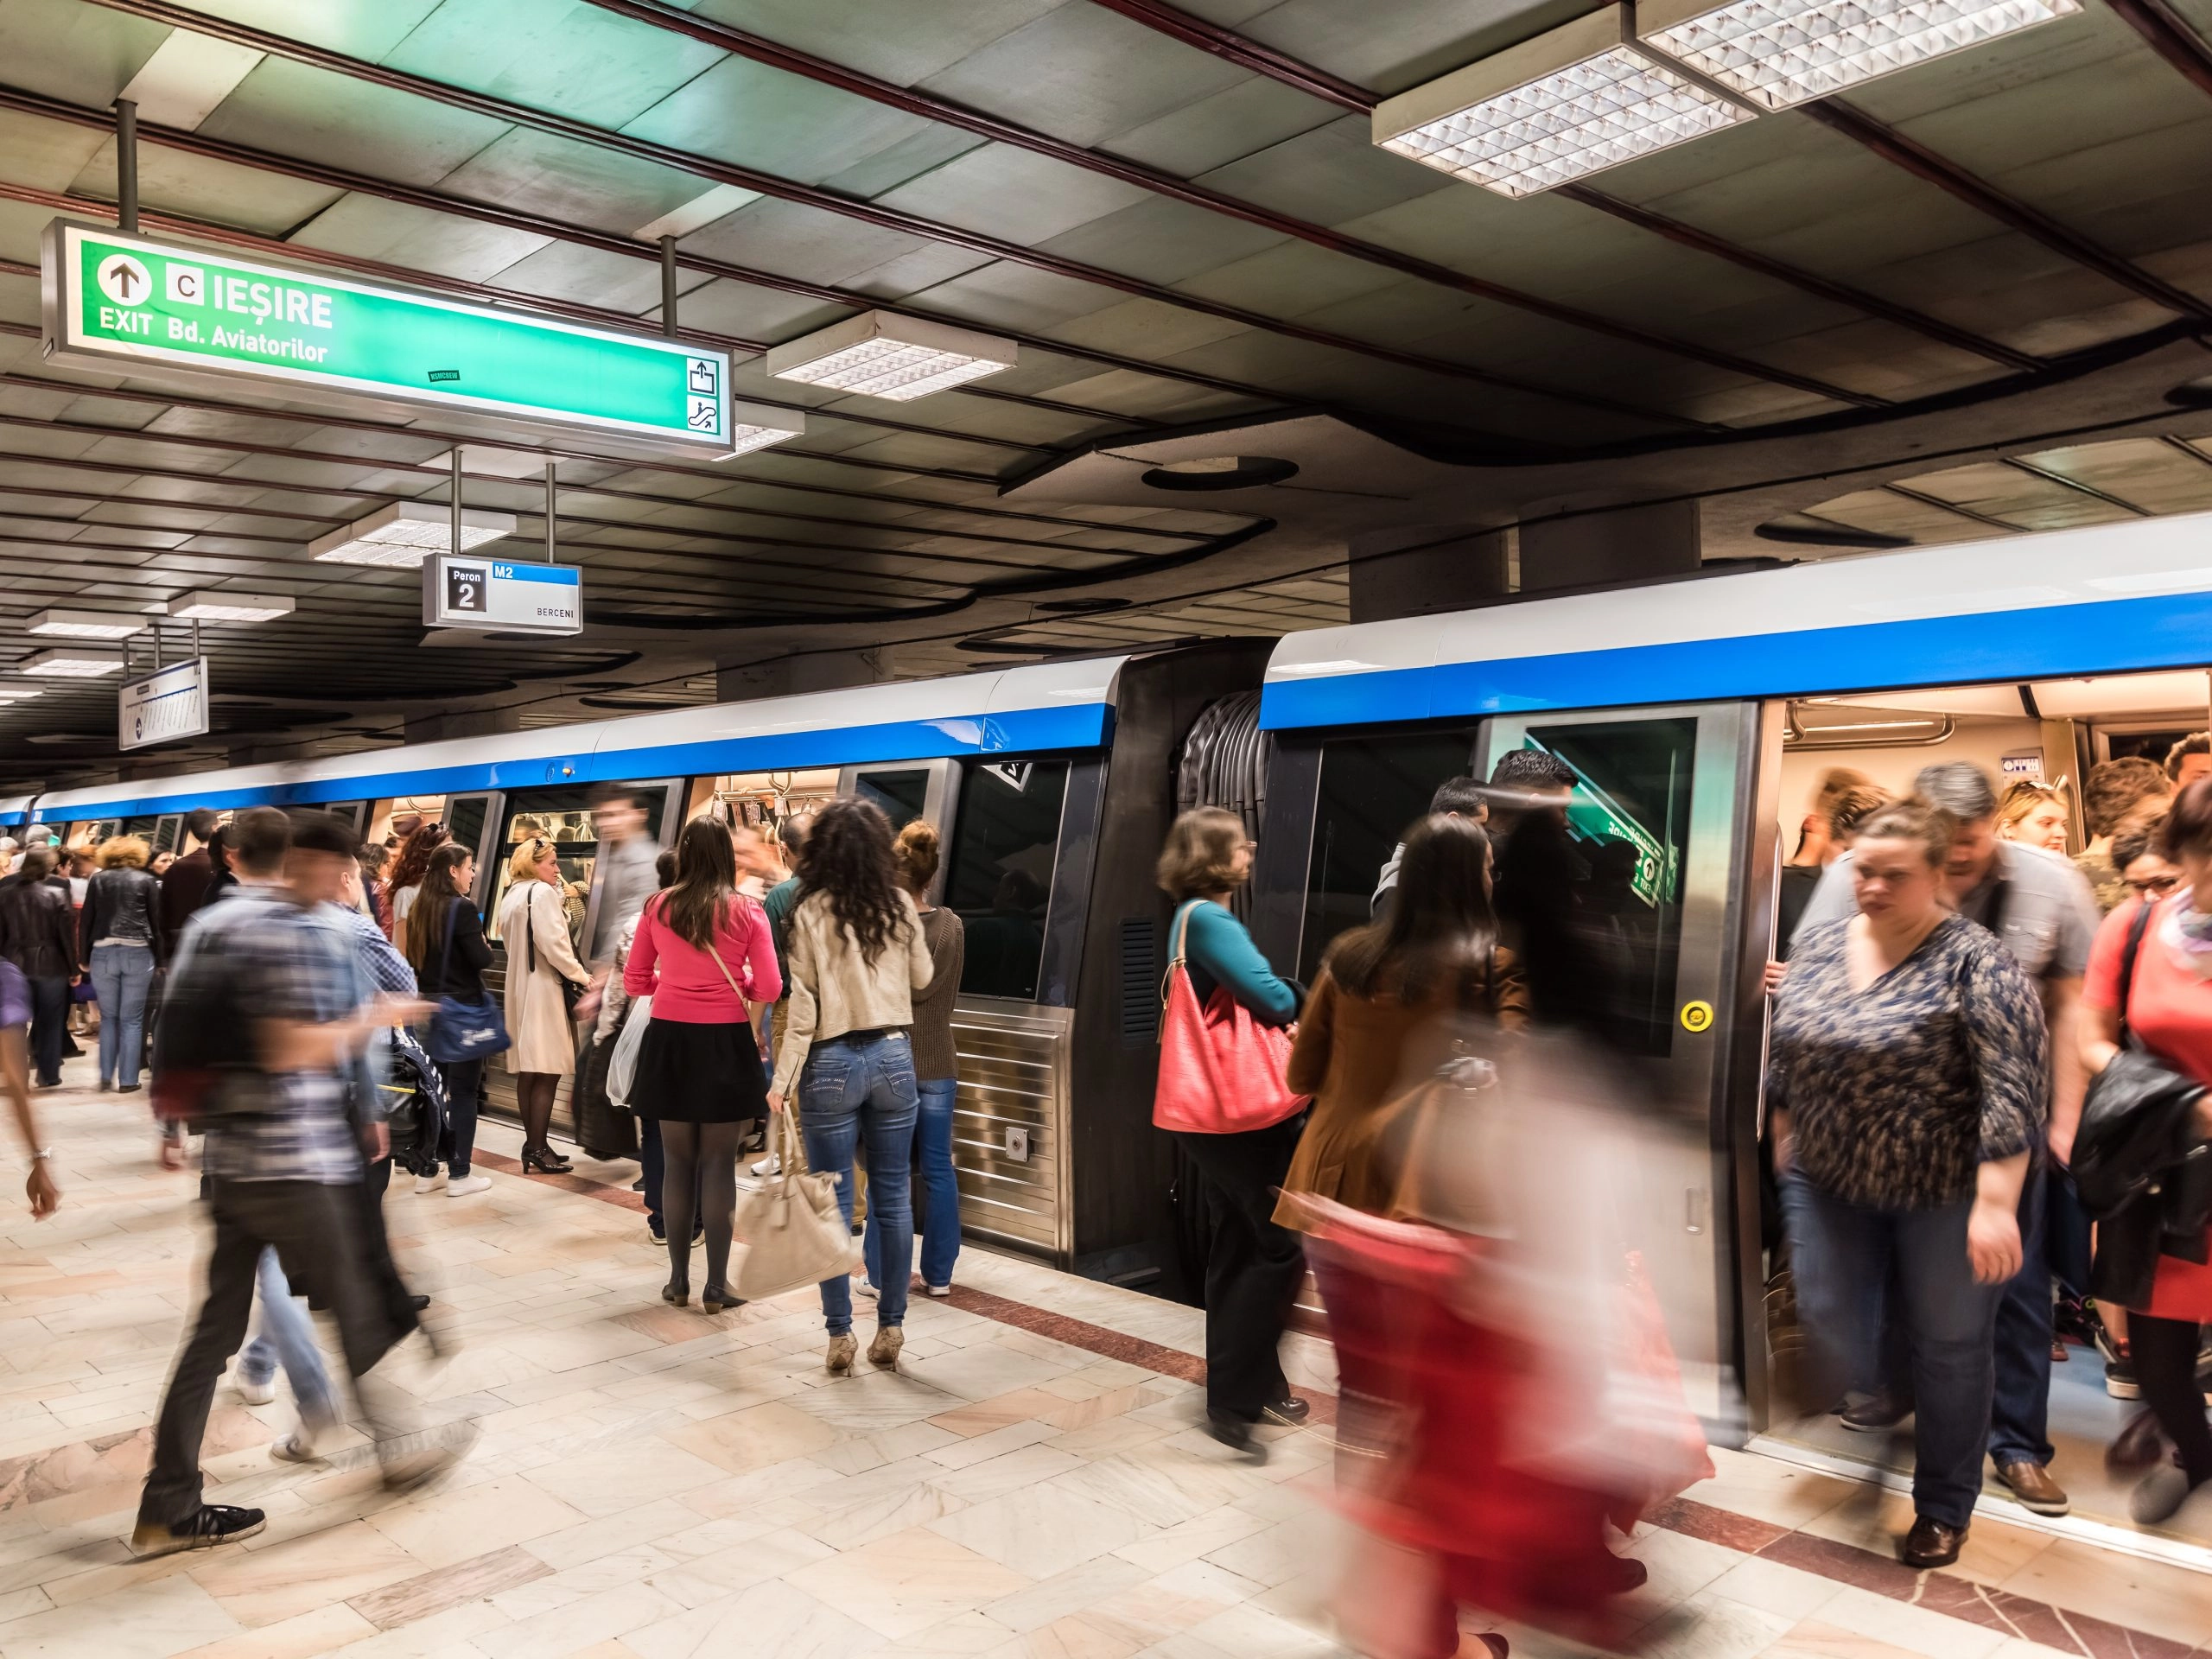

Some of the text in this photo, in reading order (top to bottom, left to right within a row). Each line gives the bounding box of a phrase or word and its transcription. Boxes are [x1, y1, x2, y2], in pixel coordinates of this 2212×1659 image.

[214, 275, 333, 329] IEȘIRE
[100, 306, 328, 363] EXIT Bd. Aviatorilor
[453, 570, 480, 582] Peron
[495, 565, 513, 579] M2
[459, 583, 474, 607] 2
[537, 607, 574, 618] BERCENI
